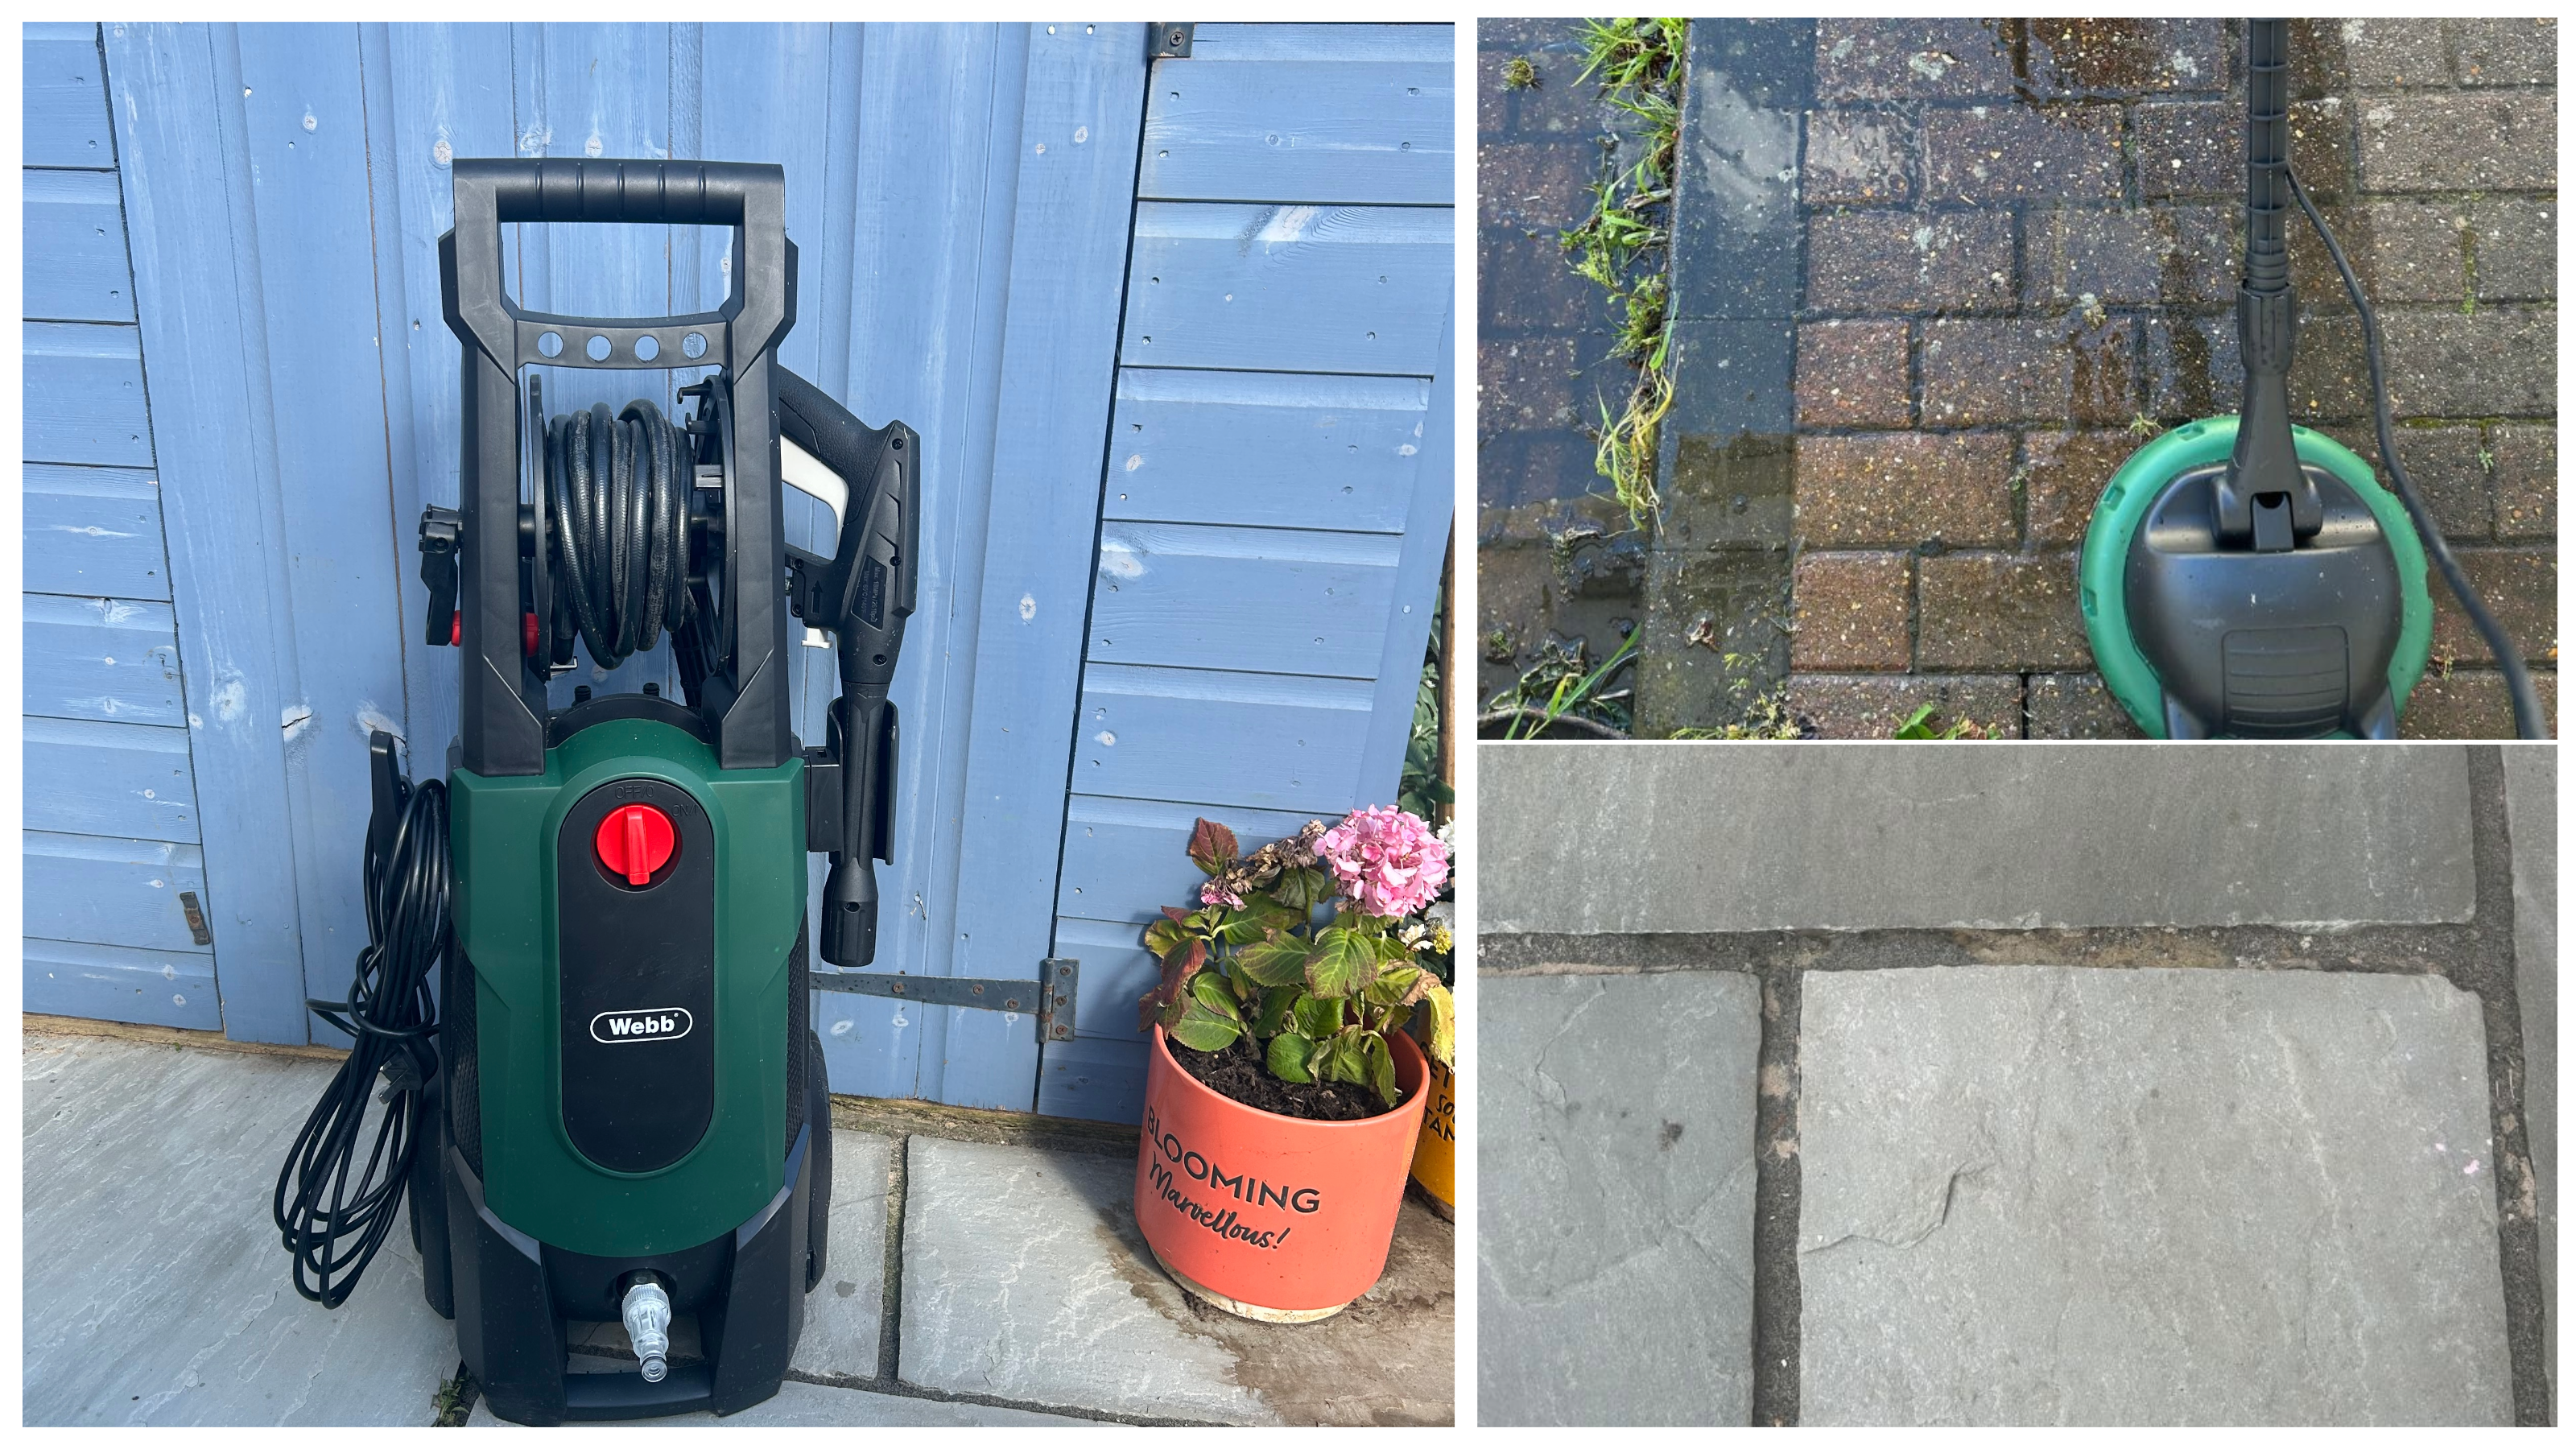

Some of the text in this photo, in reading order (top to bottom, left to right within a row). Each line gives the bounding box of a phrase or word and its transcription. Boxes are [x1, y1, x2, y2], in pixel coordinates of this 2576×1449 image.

[609, 1015, 675, 1035] Webb
[1147, 1104, 1320, 1213] BLOOMING
[1150, 1151, 1291, 1249] Marvellous!
